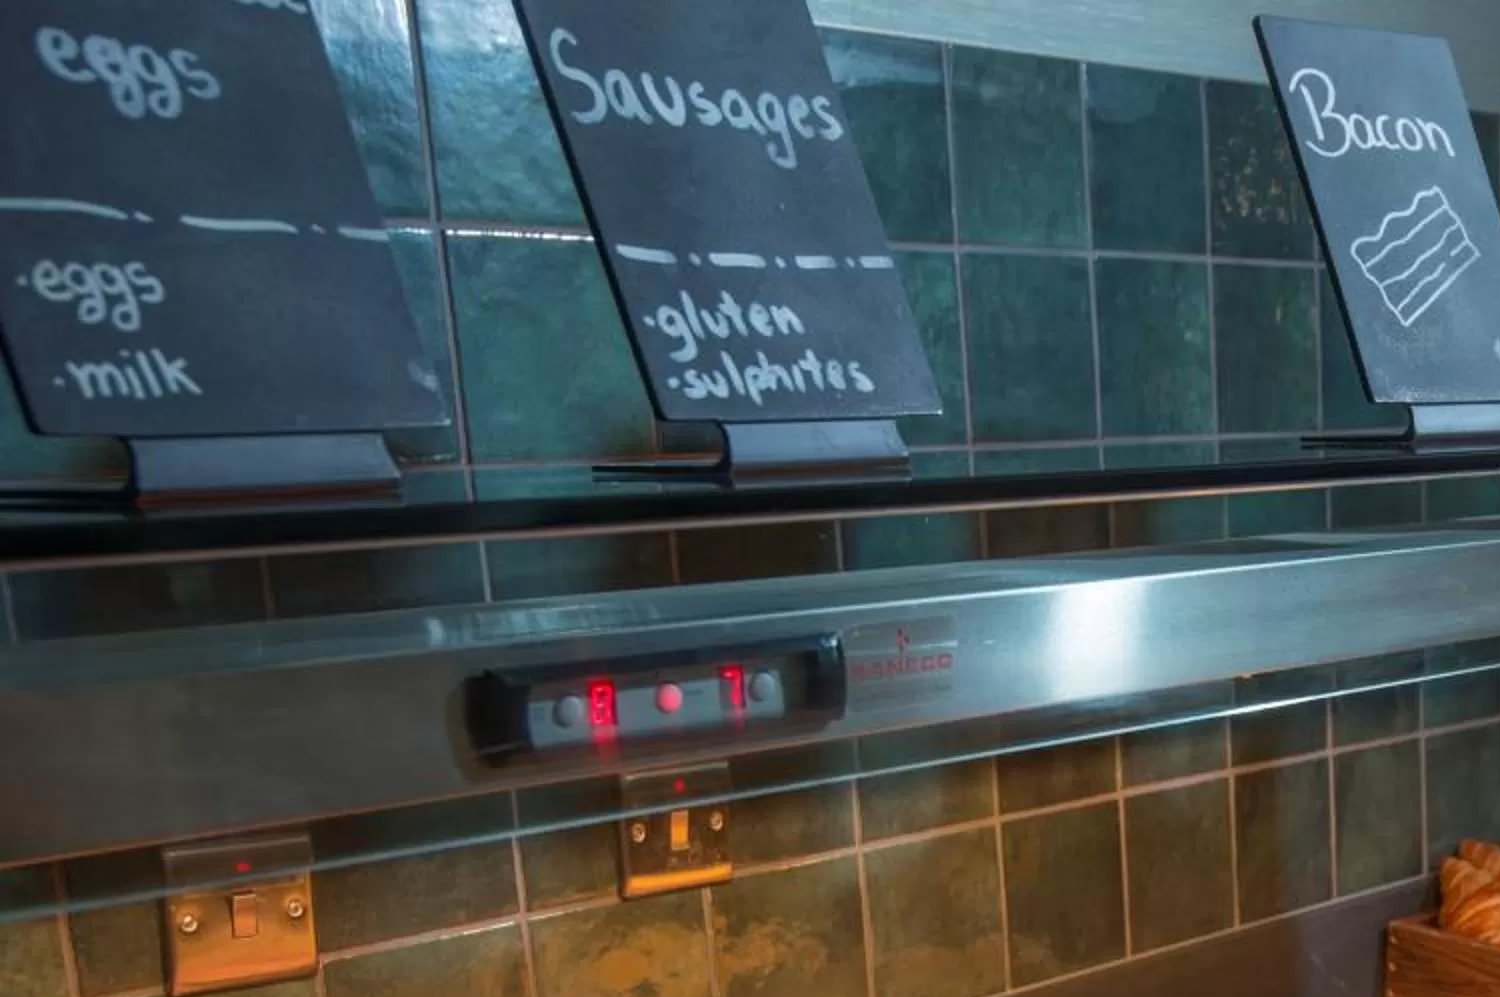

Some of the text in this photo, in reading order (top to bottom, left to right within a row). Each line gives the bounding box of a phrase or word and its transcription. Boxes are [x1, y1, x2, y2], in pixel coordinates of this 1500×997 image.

[36, 26, 221, 118] eggs
[549, 27, 845, 170] Sausages
[1289, 68, 1456, 157] Bacon
[32, 259, 164, 331] eggs
[657, 290, 805, 363] gluten
[66, 348, 203, 400] milk
